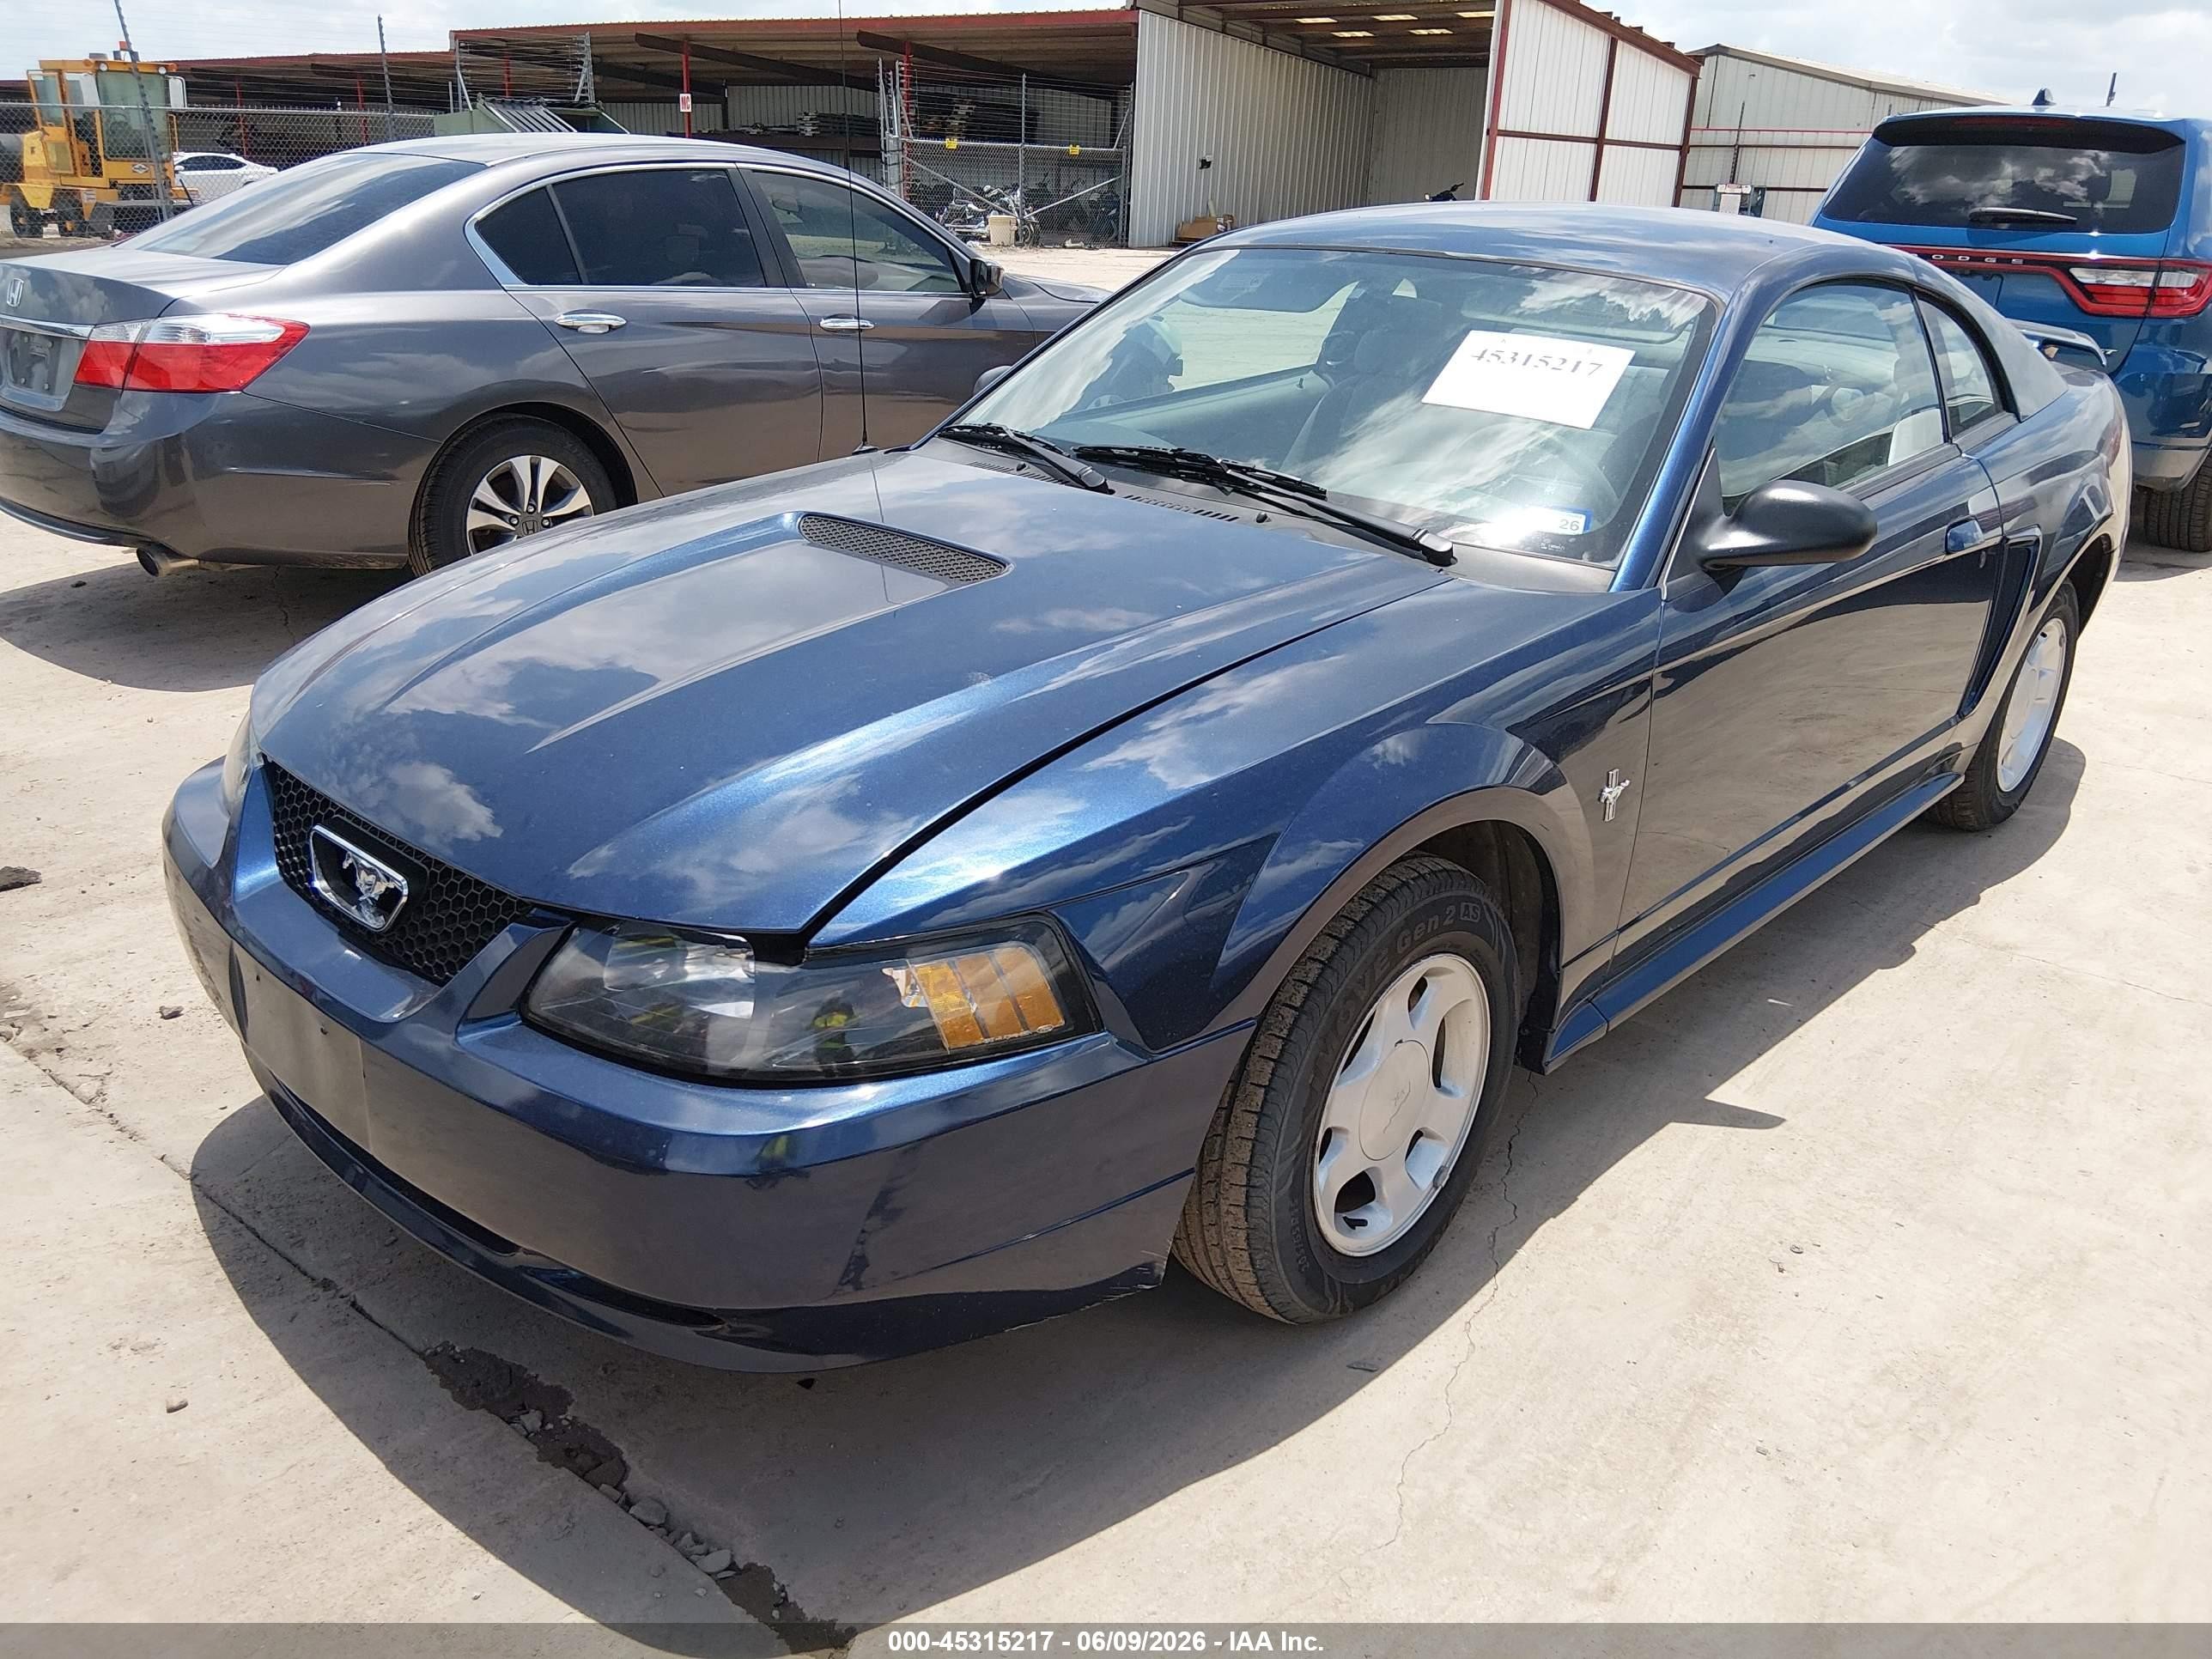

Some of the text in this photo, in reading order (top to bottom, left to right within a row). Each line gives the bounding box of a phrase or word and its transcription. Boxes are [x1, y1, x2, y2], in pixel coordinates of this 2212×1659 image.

[681, 95, 690, 111] MC
[1471, 349, 1603, 376] 45315217
[1559, 519, 1580, 532] 26
[1397, 914, 1440, 953] Gen
[1443, 905, 1456, 927] 2
[1462, 905, 1480, 921] AS
